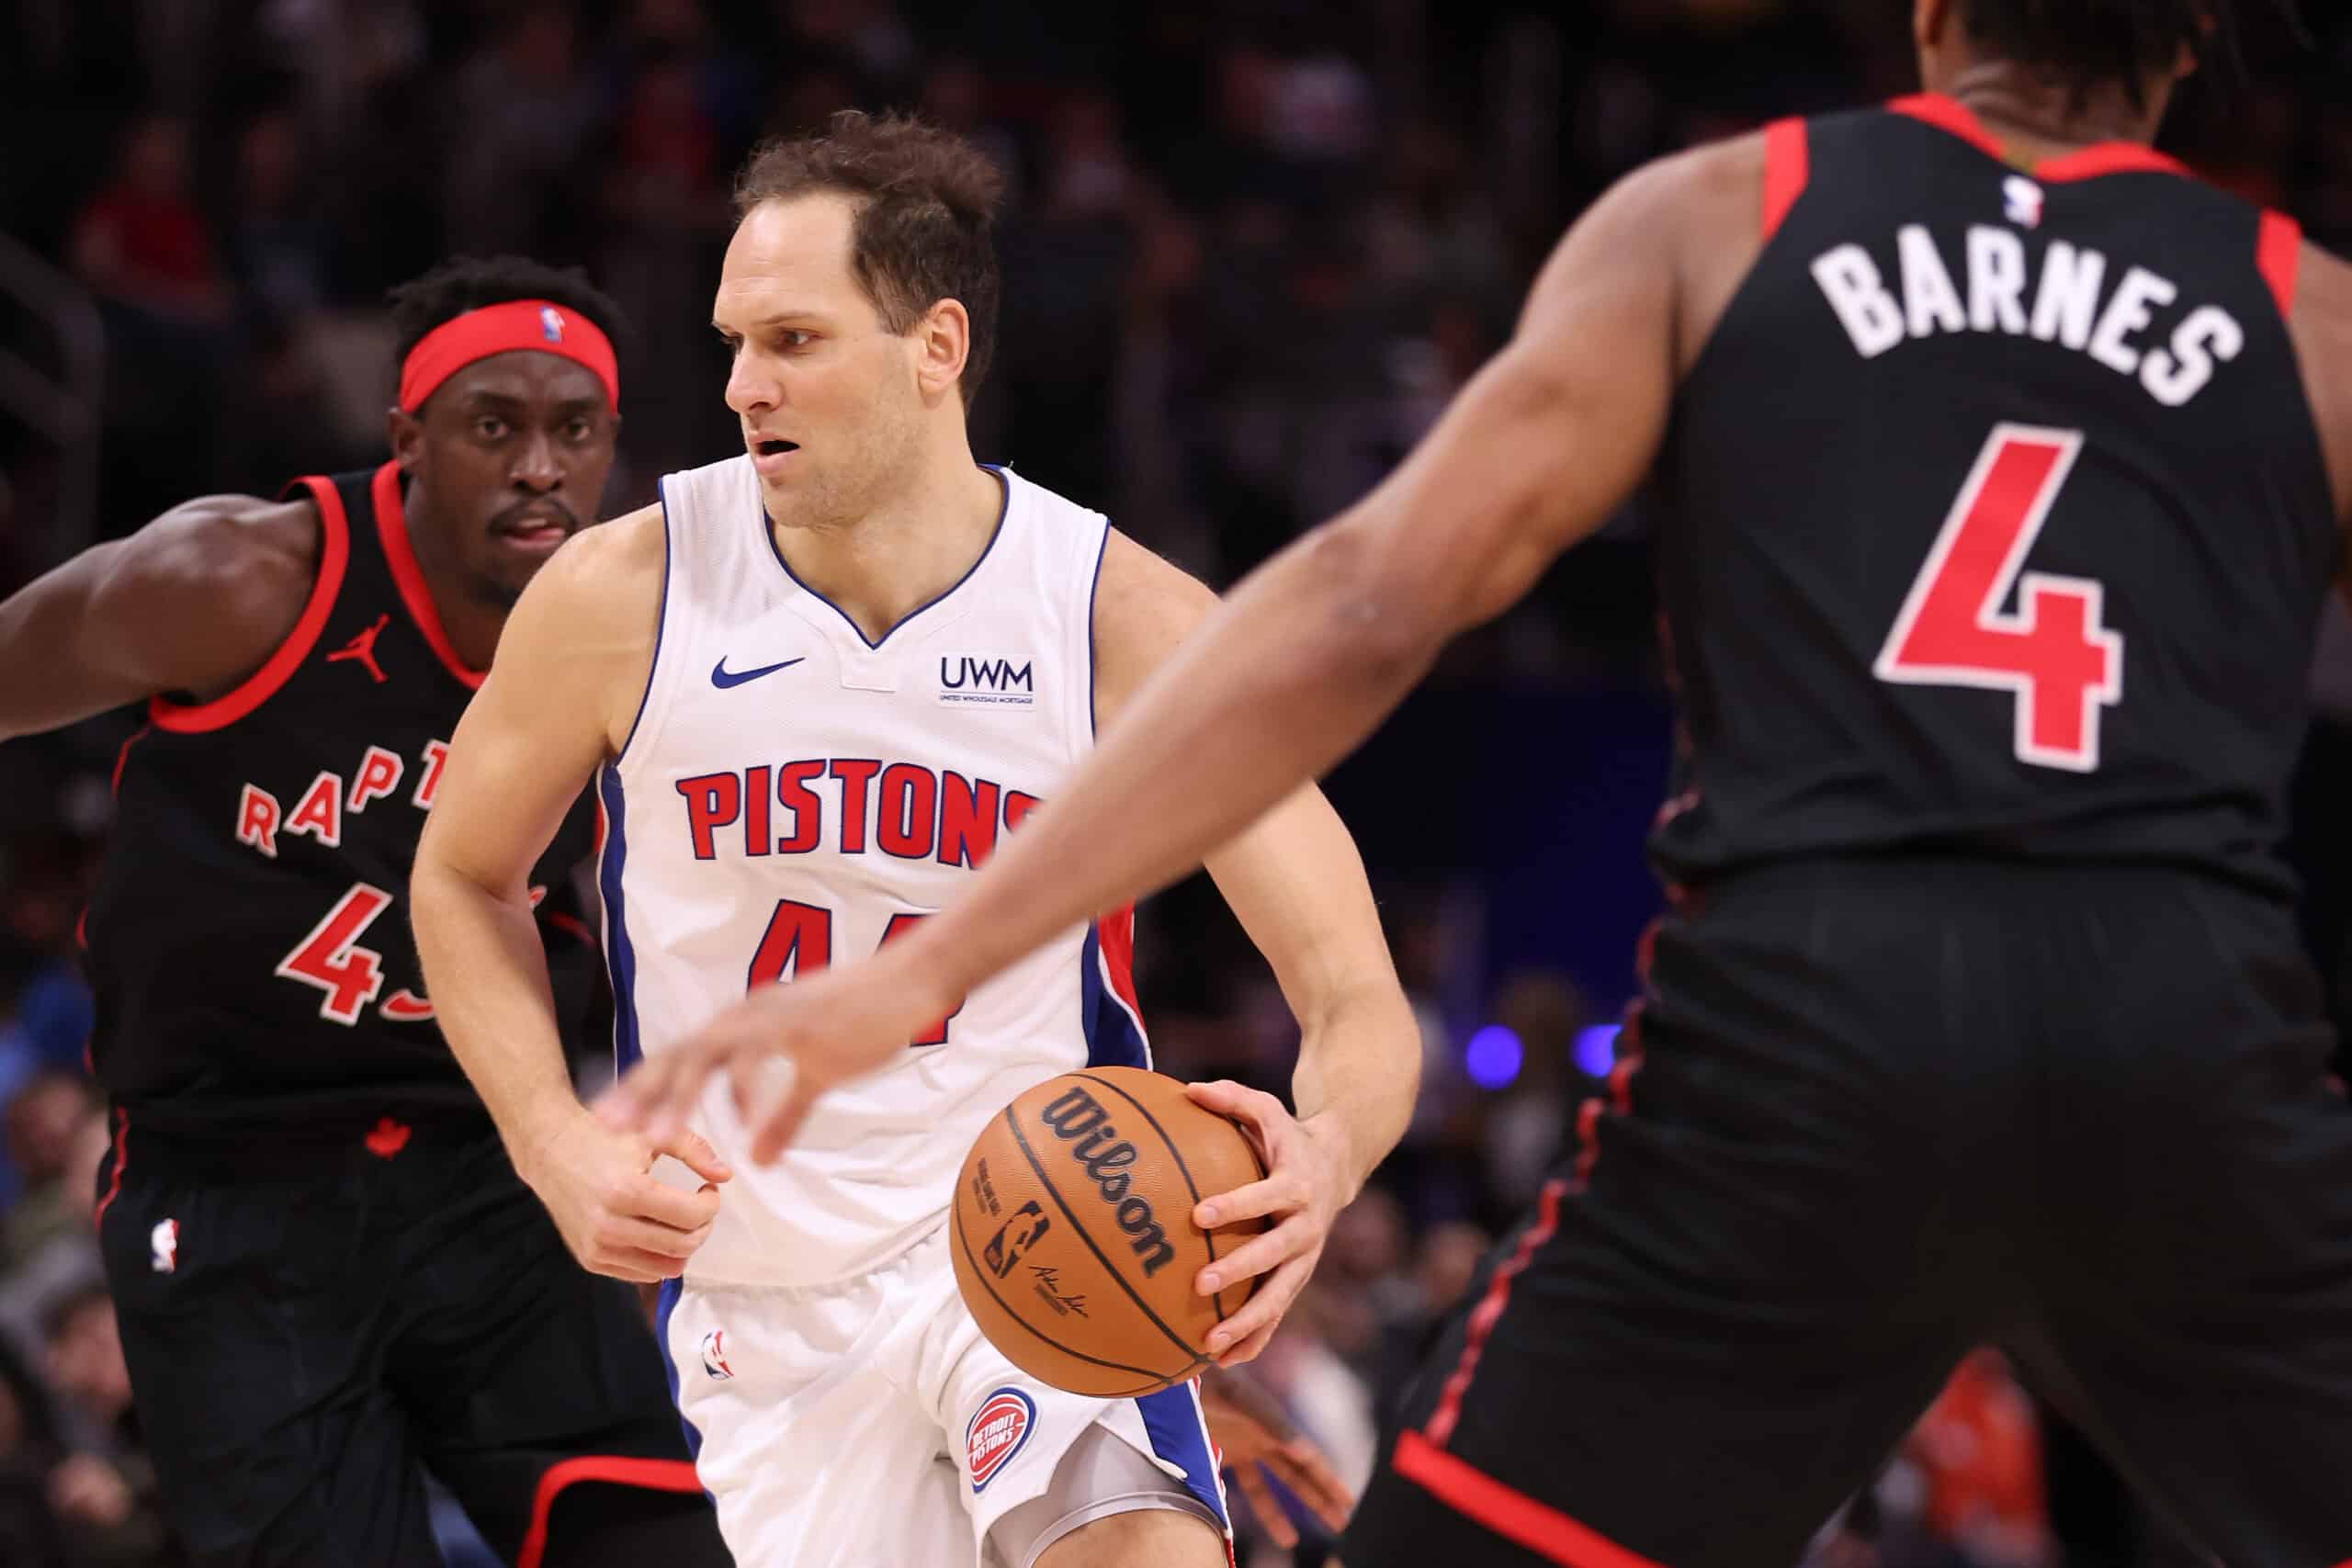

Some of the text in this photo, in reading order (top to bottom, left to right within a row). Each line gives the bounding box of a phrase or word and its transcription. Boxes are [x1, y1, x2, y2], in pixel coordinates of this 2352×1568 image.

[1811, 224, 2243, 405] BARNES
[1873, 422, 2123, 773] 4
[941, 657, 1033, 692] UWM
[236, 739, 452, 857] RAPT
[275, 882, 438, 1027] 4
[746, 898, 967, 1047] 4
[1042, 1086, 1175, 1279] Wilson
[971, 1427, 1015, 1467] PISTONS
[973, 1412, 1017, 1447] DETROIT
